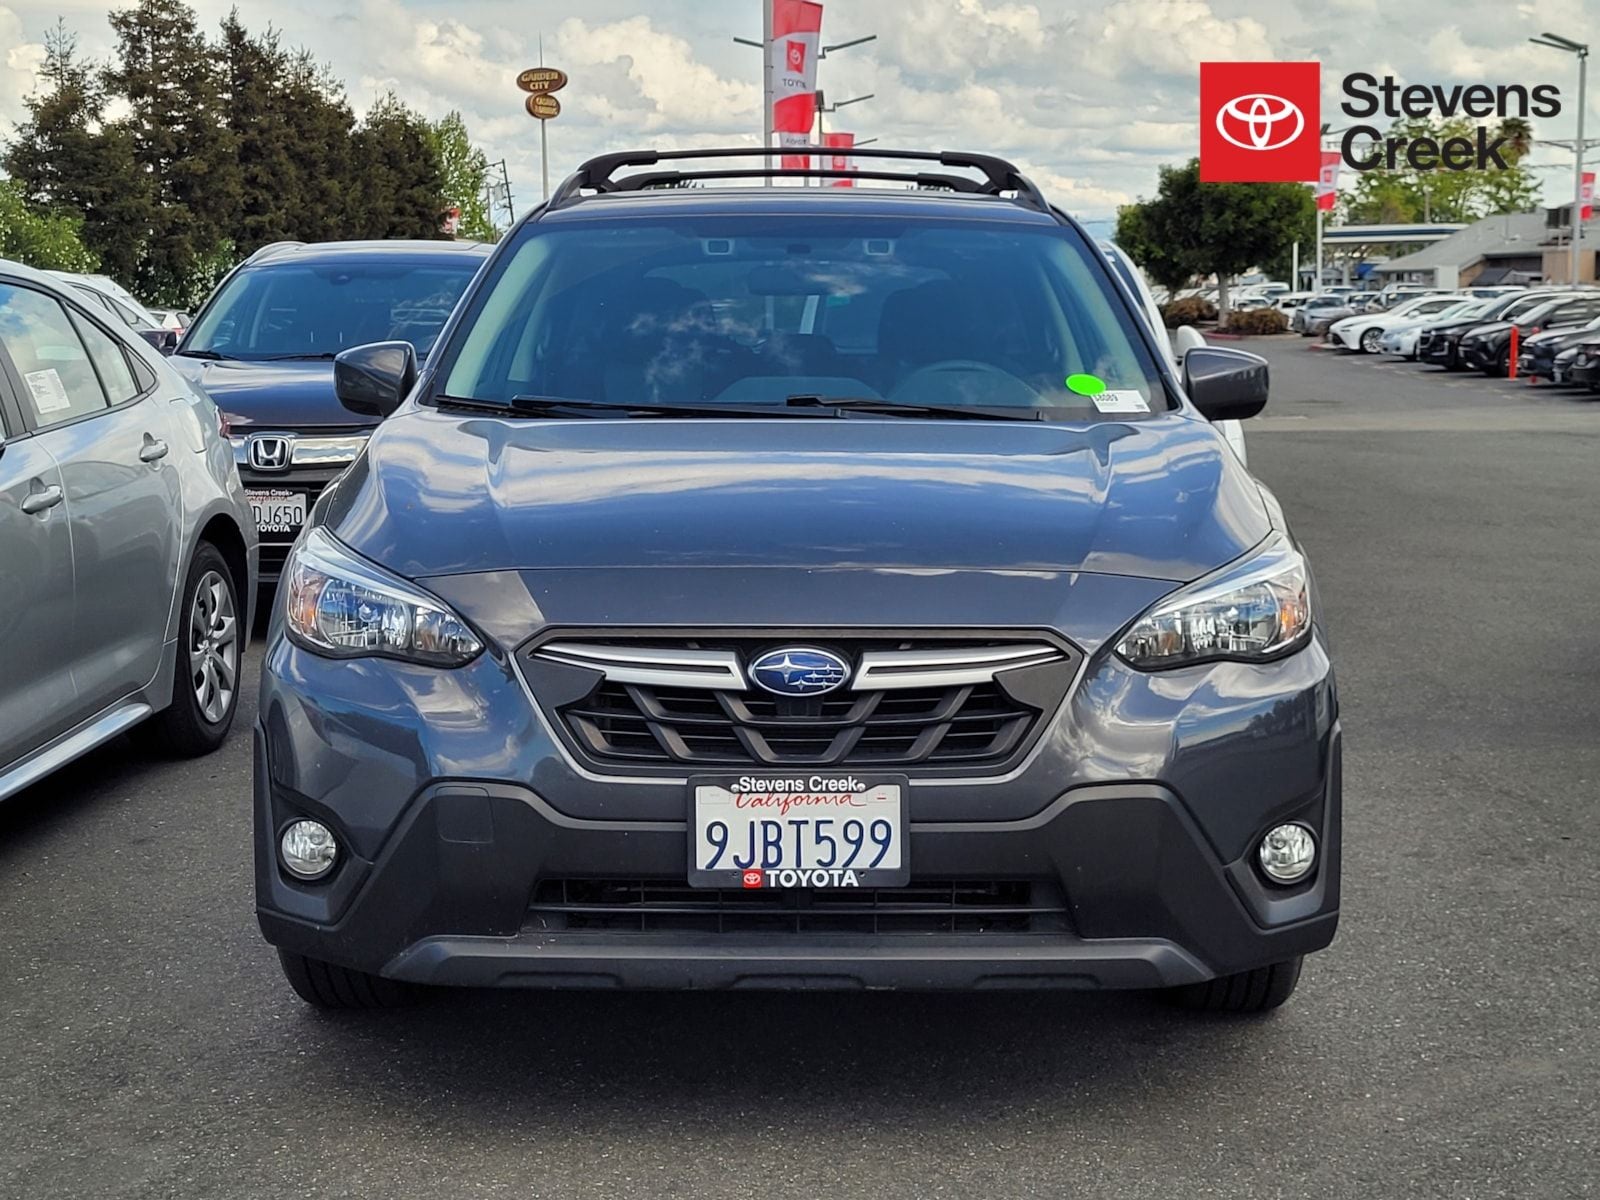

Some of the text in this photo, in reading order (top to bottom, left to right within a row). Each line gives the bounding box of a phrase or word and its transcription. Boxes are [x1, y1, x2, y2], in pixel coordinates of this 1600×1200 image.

[521, 72, 559, 82] GARDEN
[529, 81, 550, 90] CITY
[244, 489, 289, 497] Stevens Creek
[252, 505, 303, 525] DJ650
[256, 524, 291, 533] TOYOTA
[739, 776, 858, 792] Stevens Creek
[735, 792, 867, 816] California
[705, 819, 892, 869] 9JBT599
[766, 869, 859, 887] TOYOTA
